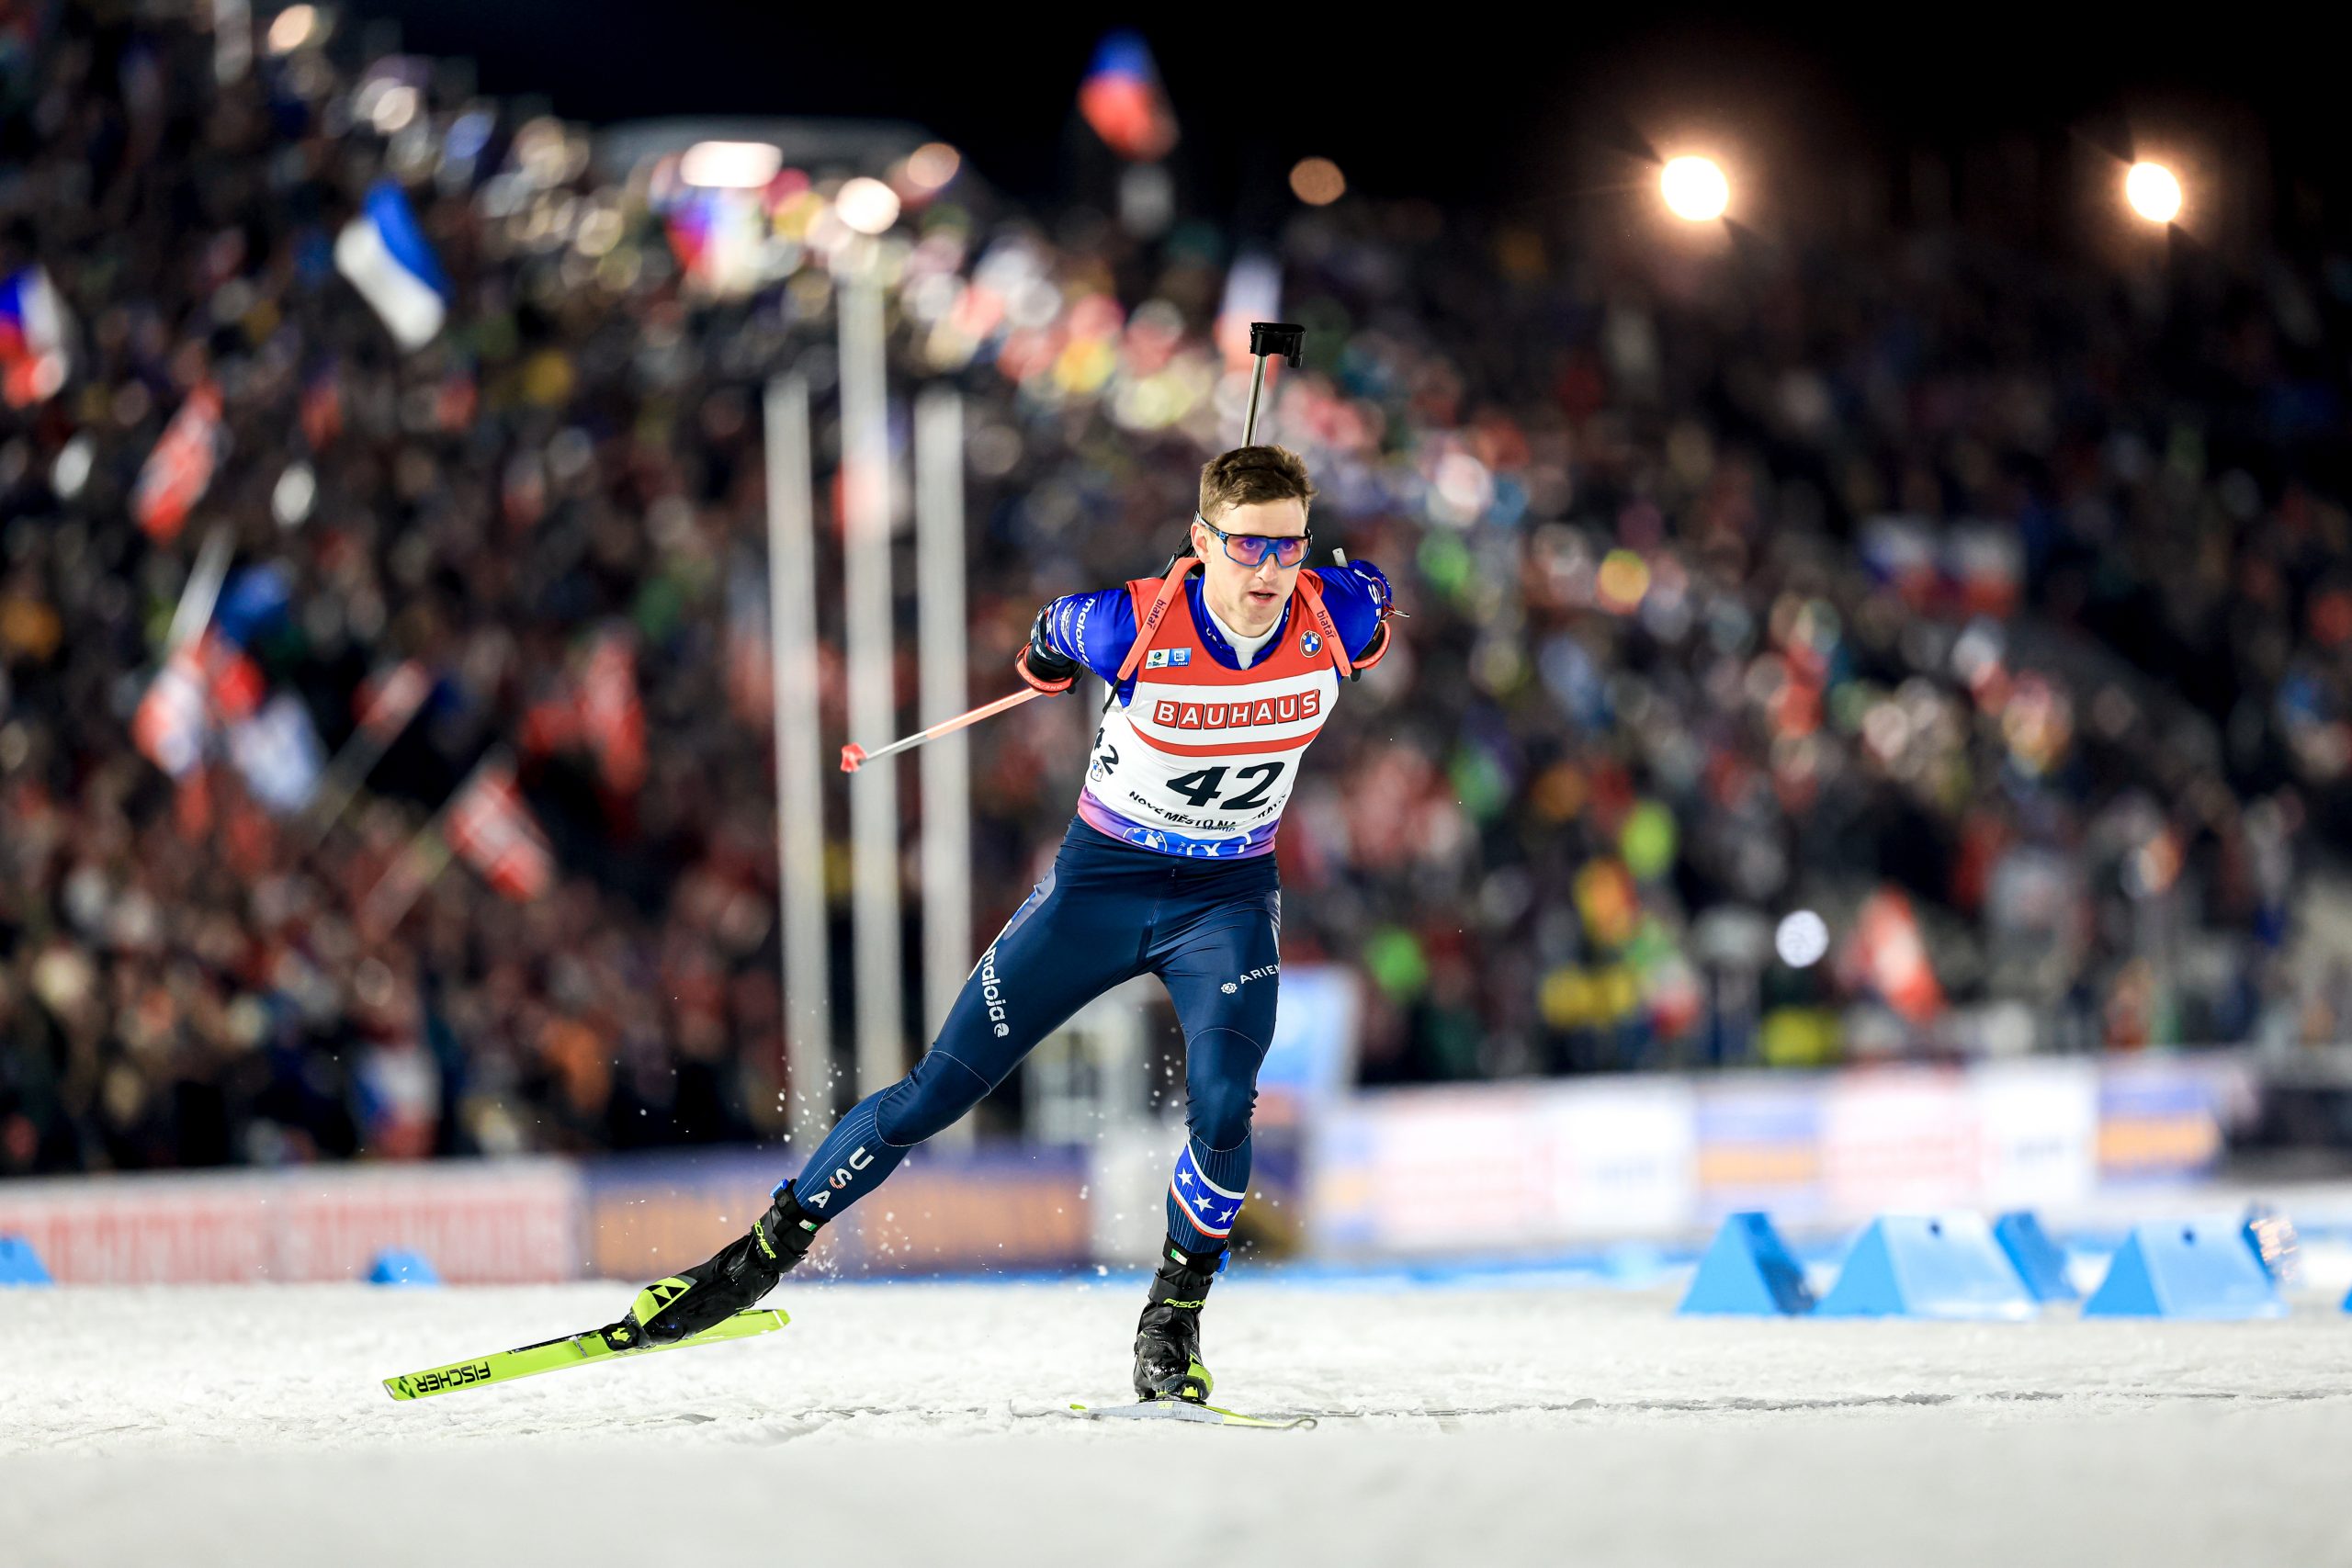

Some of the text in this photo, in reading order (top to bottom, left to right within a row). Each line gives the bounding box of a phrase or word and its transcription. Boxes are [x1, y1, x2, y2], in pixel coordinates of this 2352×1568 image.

[1147, 599, 1166, 629] biatar
[1317, 610, 1335, 638] biatar
[1156, 693, 1317, 727] BAUHAUS
[1166, 761, 1285, 809] 42
[981, 946, 1007, 1022] maloja
[808, 1146, 875, 1209] USA
[413, 1361, 492, 1393] FISCHER
